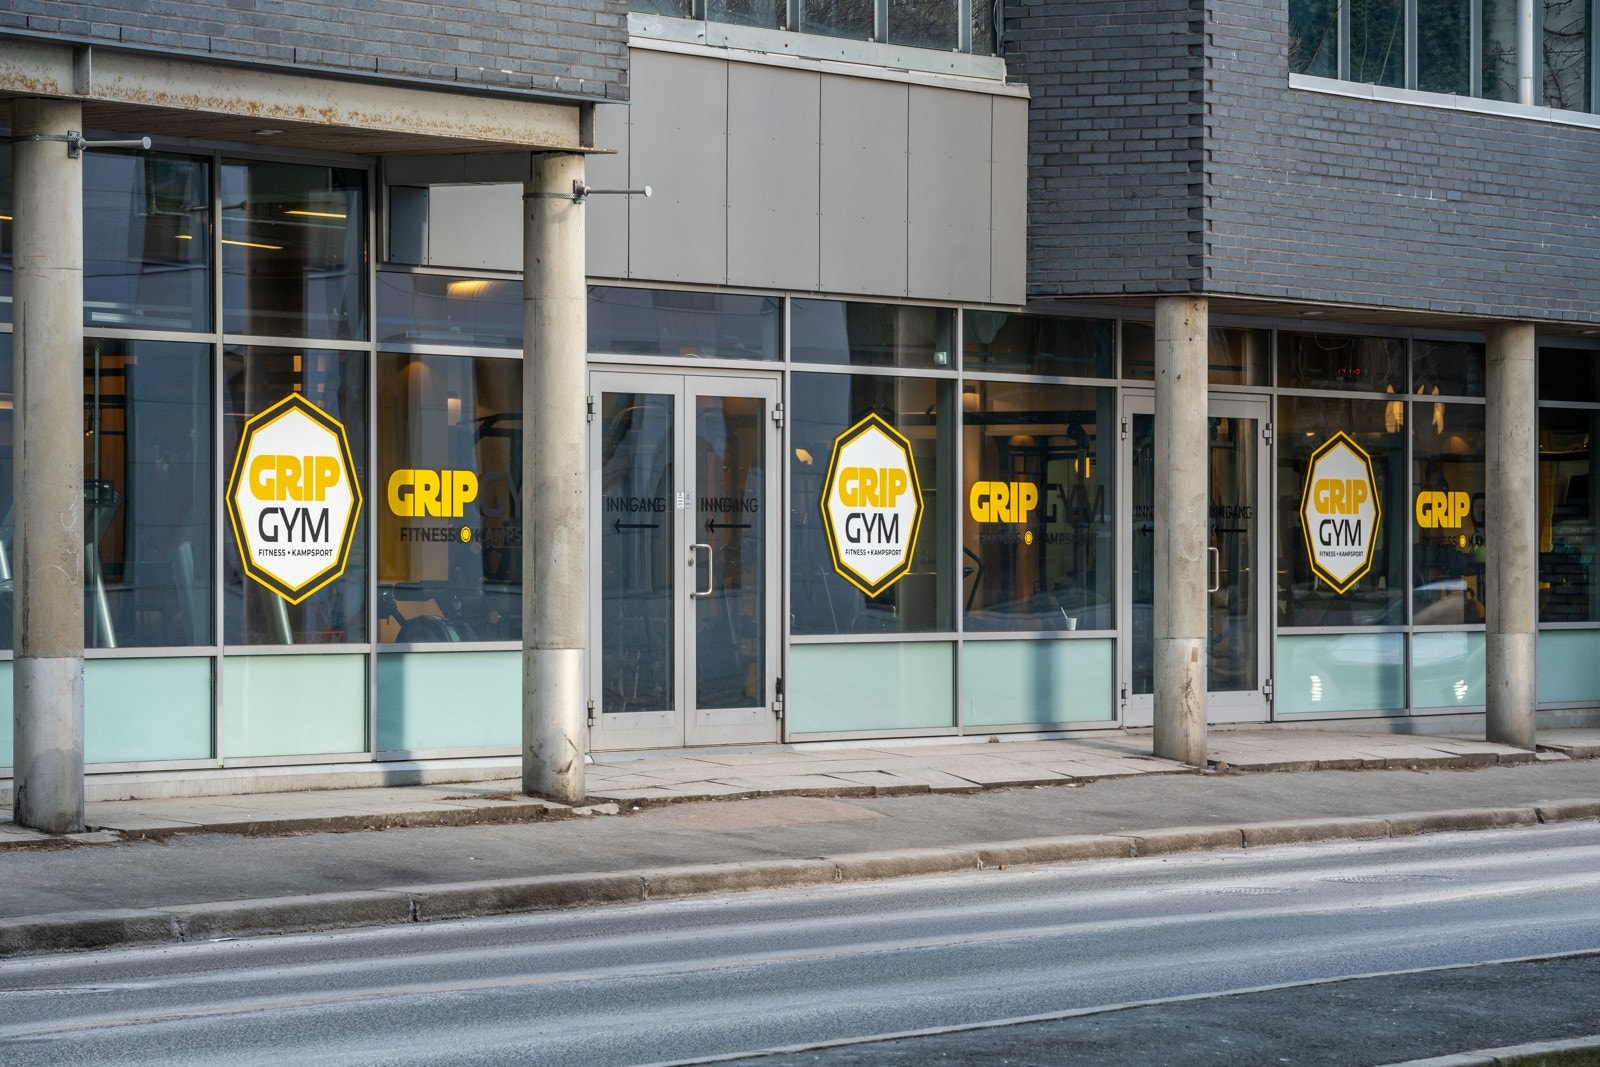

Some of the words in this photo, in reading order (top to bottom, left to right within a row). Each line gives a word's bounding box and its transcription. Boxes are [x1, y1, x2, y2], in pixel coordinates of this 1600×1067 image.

[249, 454, 340, 501] GRIP
[838, 466, 907, 508] GRIP
[387, 469, 479, 518] GRIP
[606, 496, 666, 513] INNGANG
[701, 496, 759, 513] INNGANG
[969, 481, 1038, 524] GRIP
[1313, 478, 1368, 514] GRIP
[258, 507, 329, 543] GYM
[1415, 490, 1470, 529] GRIP
[400, 527, 456, 543] FITNESS
[845, 513, 899, 544] GYM
[1319, 518, 1361, 547] GYM
[258, 548, 286, 557] FITNESS
[291, 548, 333, 557] KAMPSPORT
[845, 548, 867, 556] FITNESS
[870, 548, 902, 556] KAMPSPORT
[1319, 550, 1336, 558] FITNESS
[1338, 550, 1364, 558] KAMPSPORT
